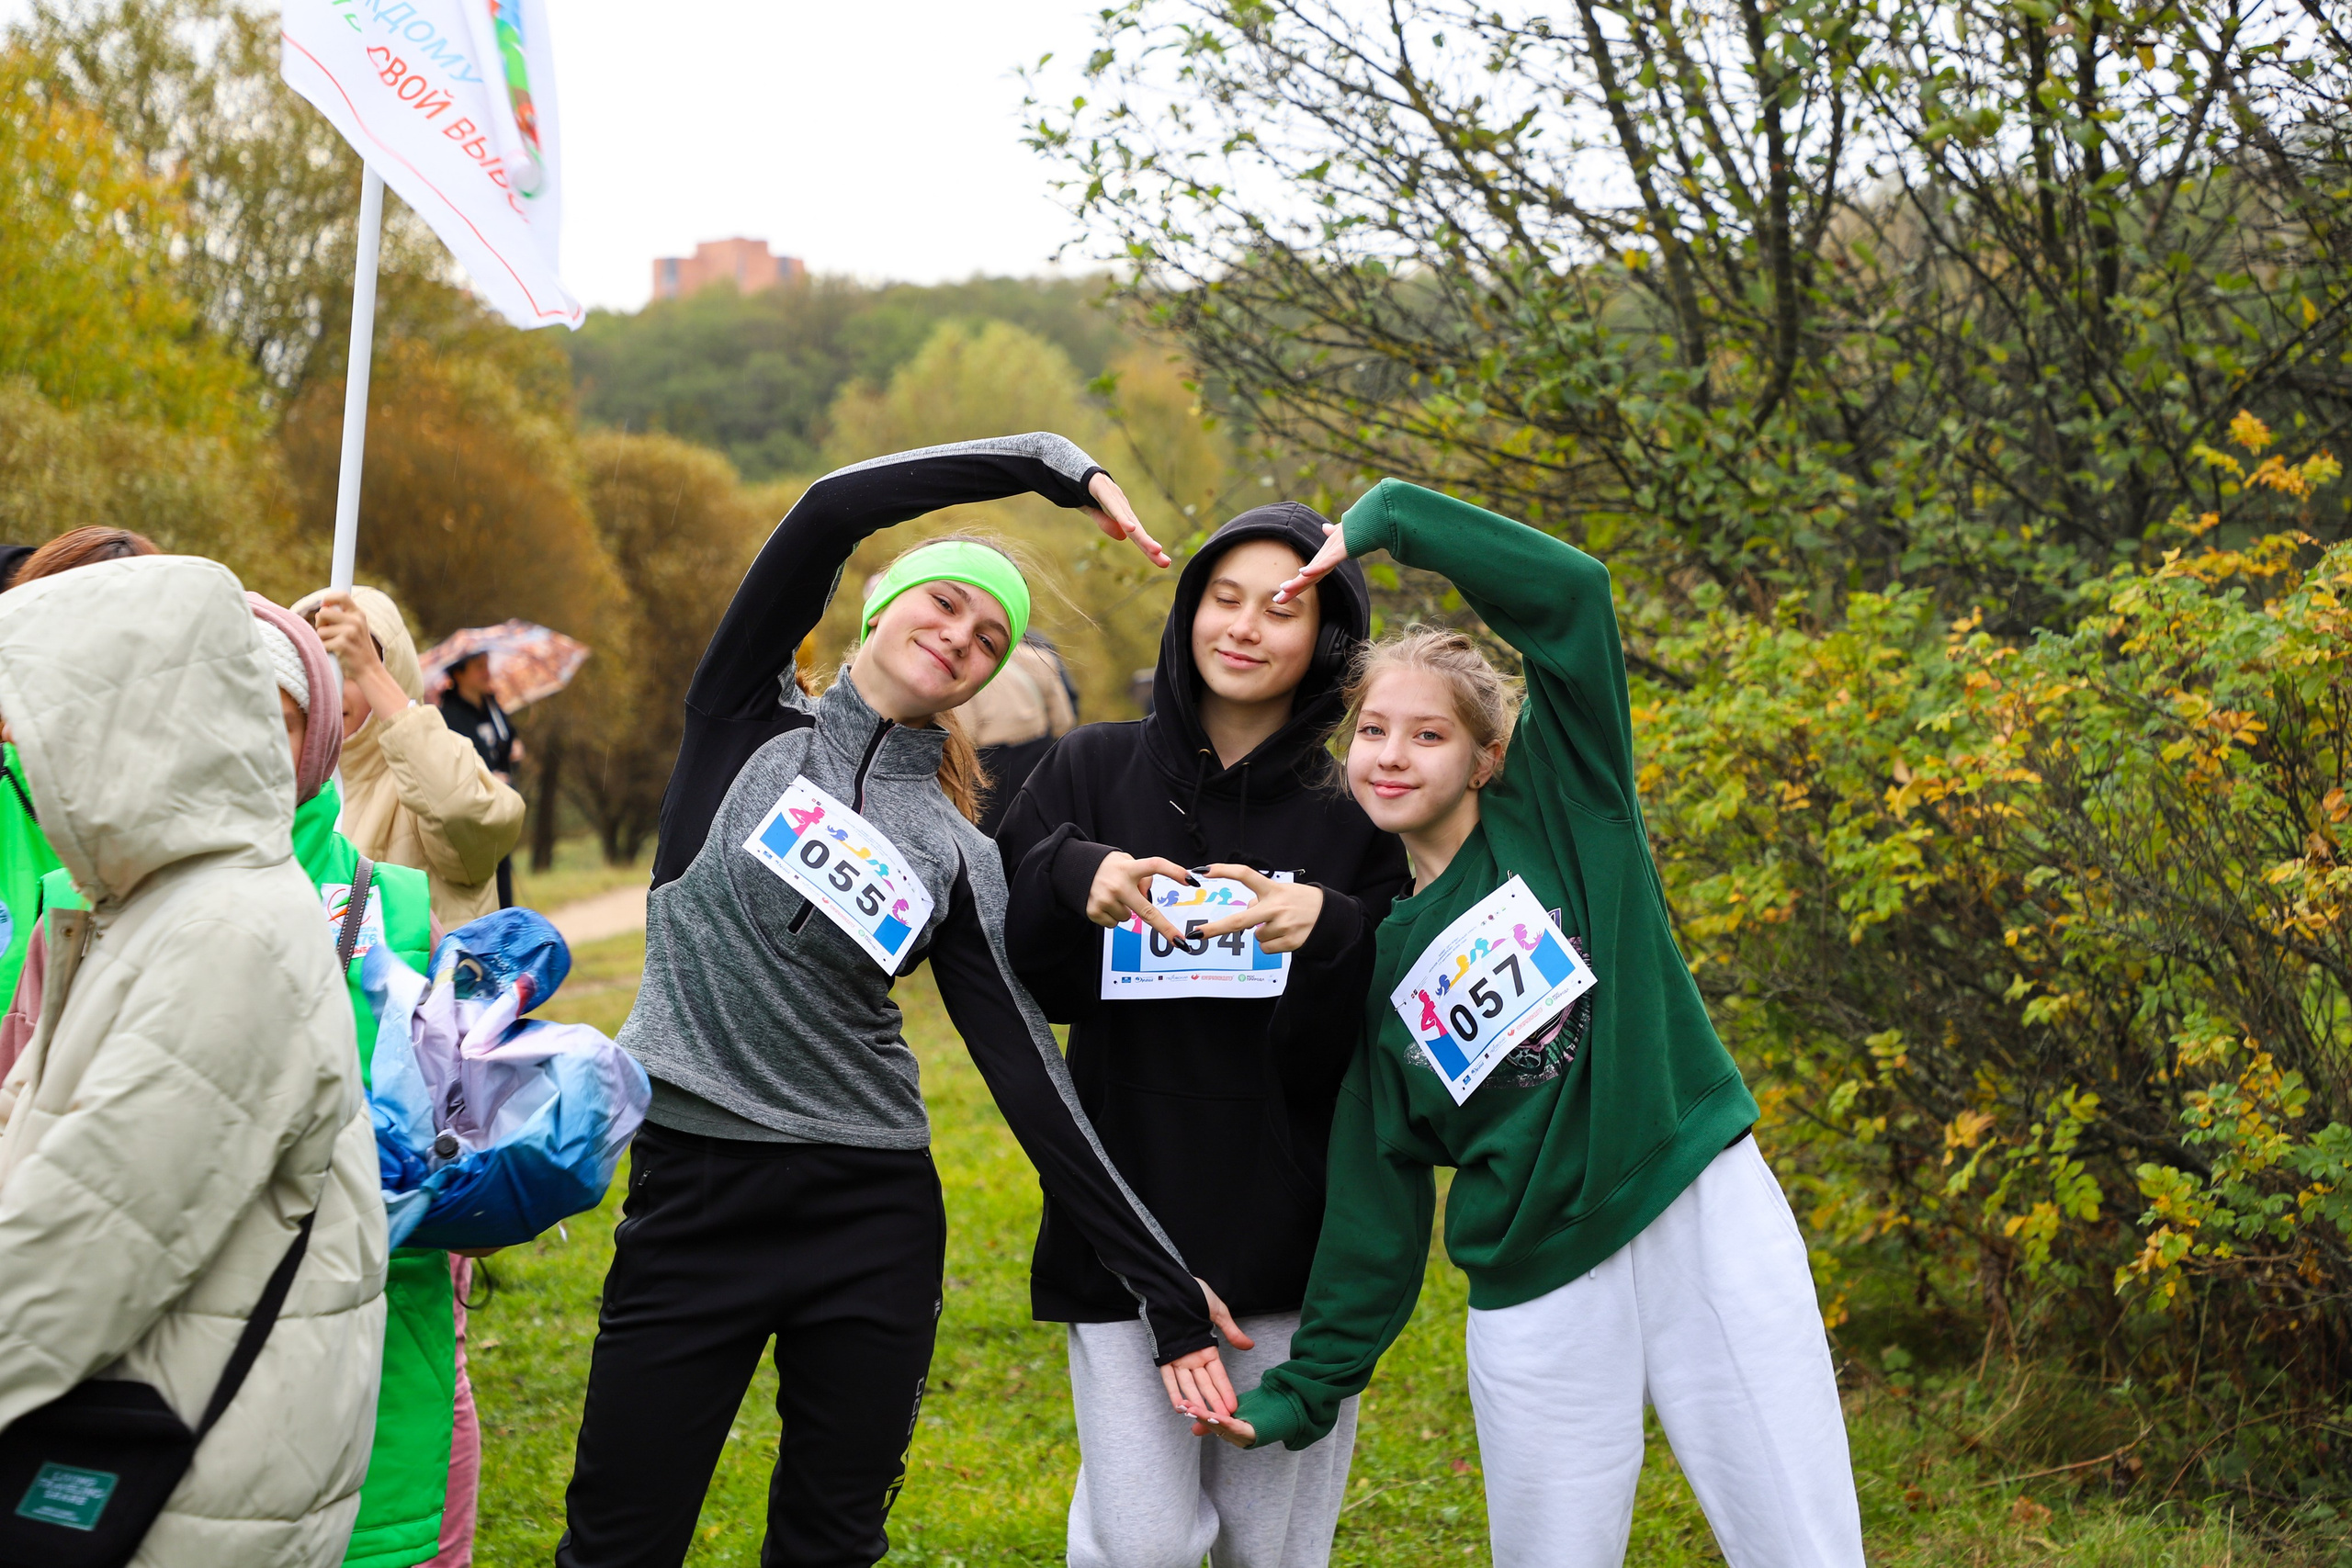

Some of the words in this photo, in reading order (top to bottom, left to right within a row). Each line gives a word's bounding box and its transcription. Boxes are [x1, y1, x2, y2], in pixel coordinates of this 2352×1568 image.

[367, 46, 455, 119] СВОЙ
[442, 116, 530, 224] ВЫБ
[799, 840, 887, 917] 055
[1449, 953, 1525, 1043] 057
